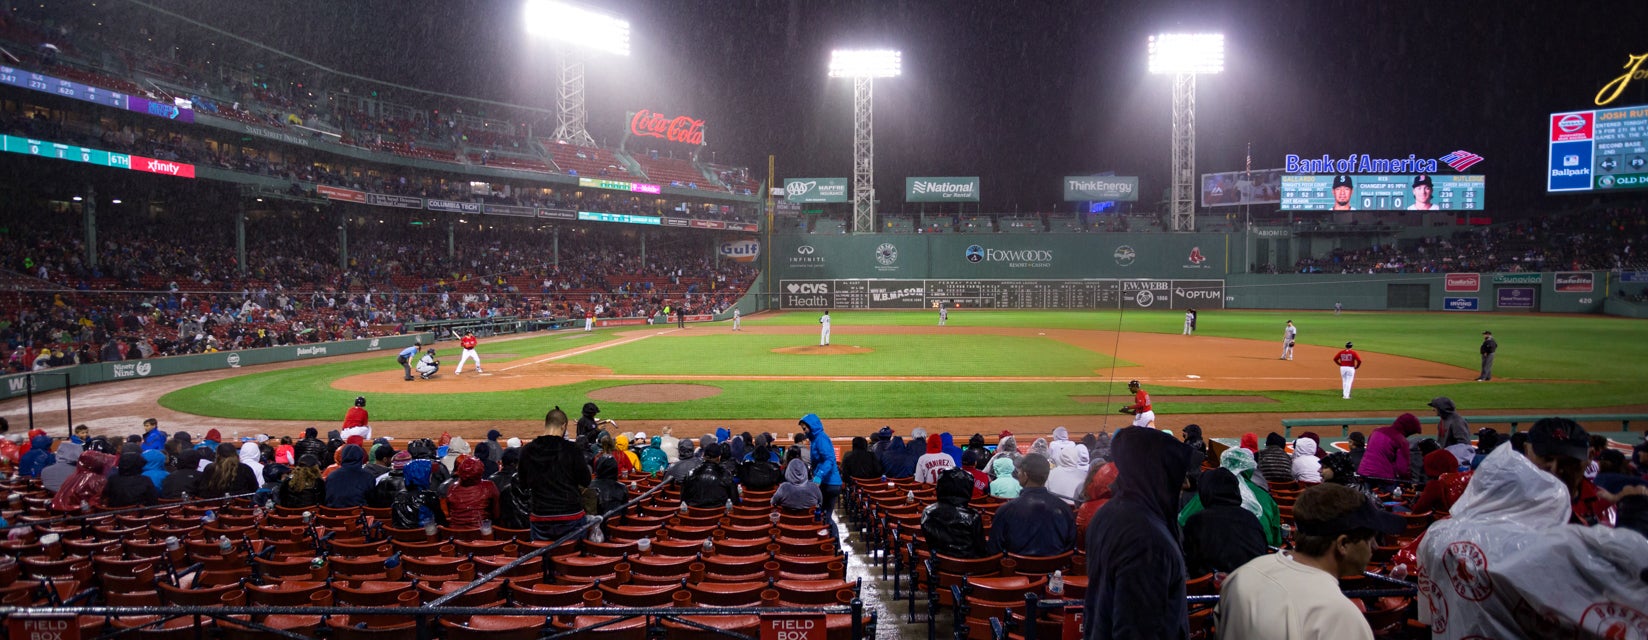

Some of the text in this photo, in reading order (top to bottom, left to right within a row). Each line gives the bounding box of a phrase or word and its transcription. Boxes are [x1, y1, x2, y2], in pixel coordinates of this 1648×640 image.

[1600, 111, 1626, 120] JOSH
[264, 129, 282, 140] STREET
[283, 133, 309, 146] PAVILION
[32, 145, 39, 155] 0
[111, 155, 128, 165] 6TH
[1286, 153, 1438, 173] Bank of America
[1601, 160, 1617, 168] 4-3
[1632, 158, 1644, 166] F9
[148, 160, 180, 175] xfinity
[1551, 167, 1590, 177] Ballpark
[1616, 176, 1638, 185] OLD
[926, 182, 974, 193] National
[1069, 180, 1132, 193] ThinkEnergy
[429, 200, 478, 211] COLUMBIA TECH
[1364, 198, 1371, 208] 0
[1394, 198, 1401, 208] 0
[720, 243, 758, 254] Gulf
[986, 248, 1053, 262] FOXWOODS
[800, 283, 828, 294] CVS
[1142, 281, 1169, 290] WEBB
[1185, 290, 1221, 299] OPTUM
[788, 295, 828, 306] Health
[114, 370, 135, 378] Nine
[925, 459, 950, 469] RAMIREZ
[24, 620, 67, 630] FIELD
[772, 620, 814, 630] FIELD
[31, 632, 62, 640] BOX
[777, 631, 808, 640] BOX
